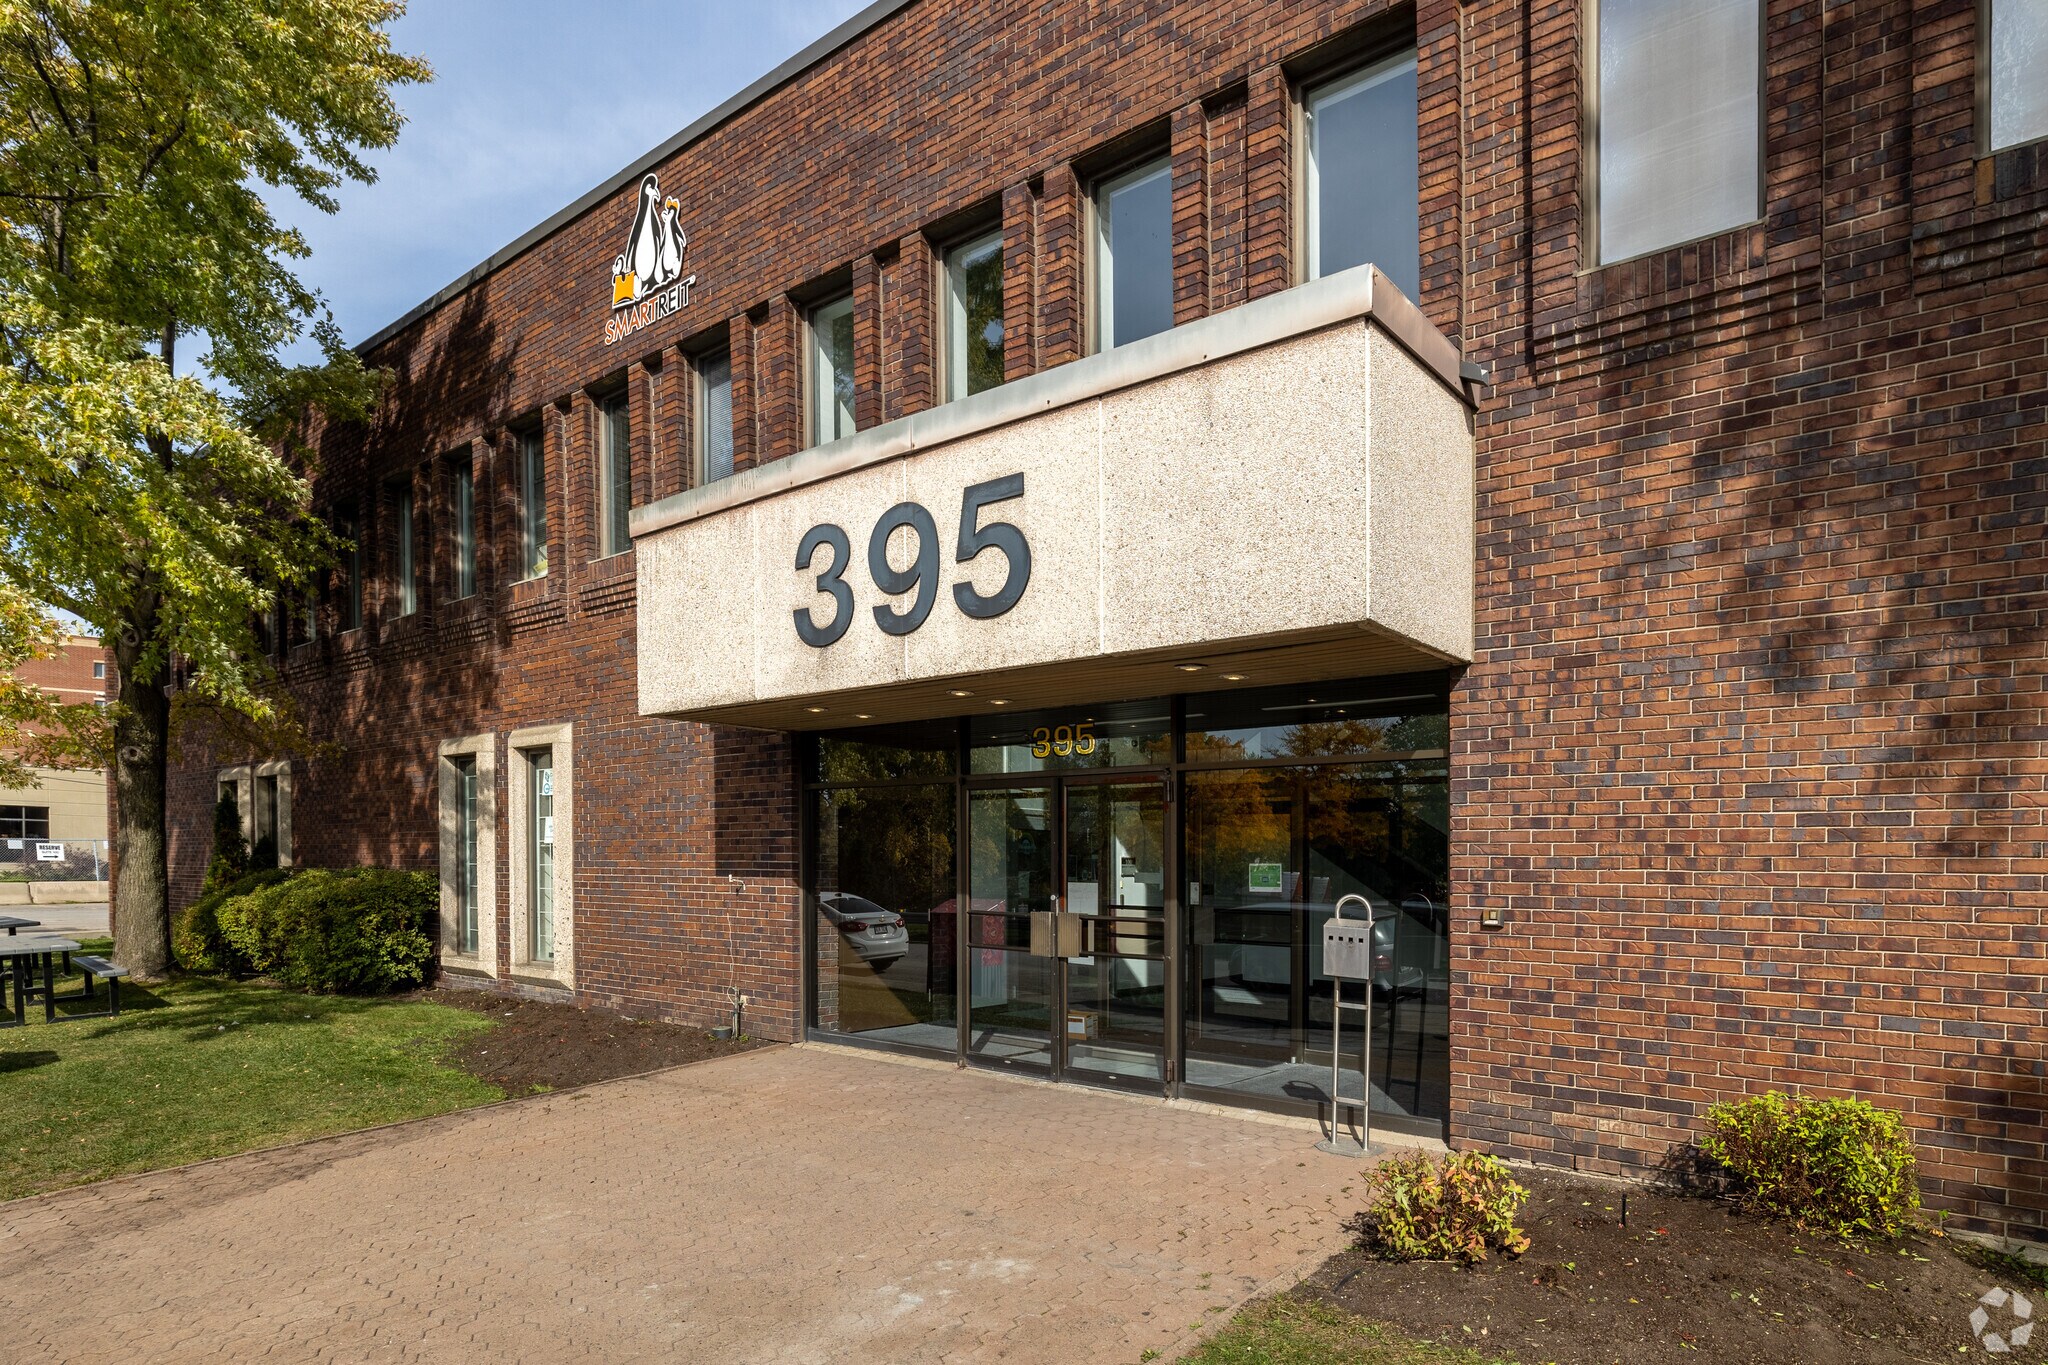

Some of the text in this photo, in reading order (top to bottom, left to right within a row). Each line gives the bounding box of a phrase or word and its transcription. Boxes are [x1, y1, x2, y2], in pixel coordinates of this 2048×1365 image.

[605, 276, 695, 345] SMARTREIT
[793, 471, 1032, 648] 395
[1032, 723, 1096, 759] 395
